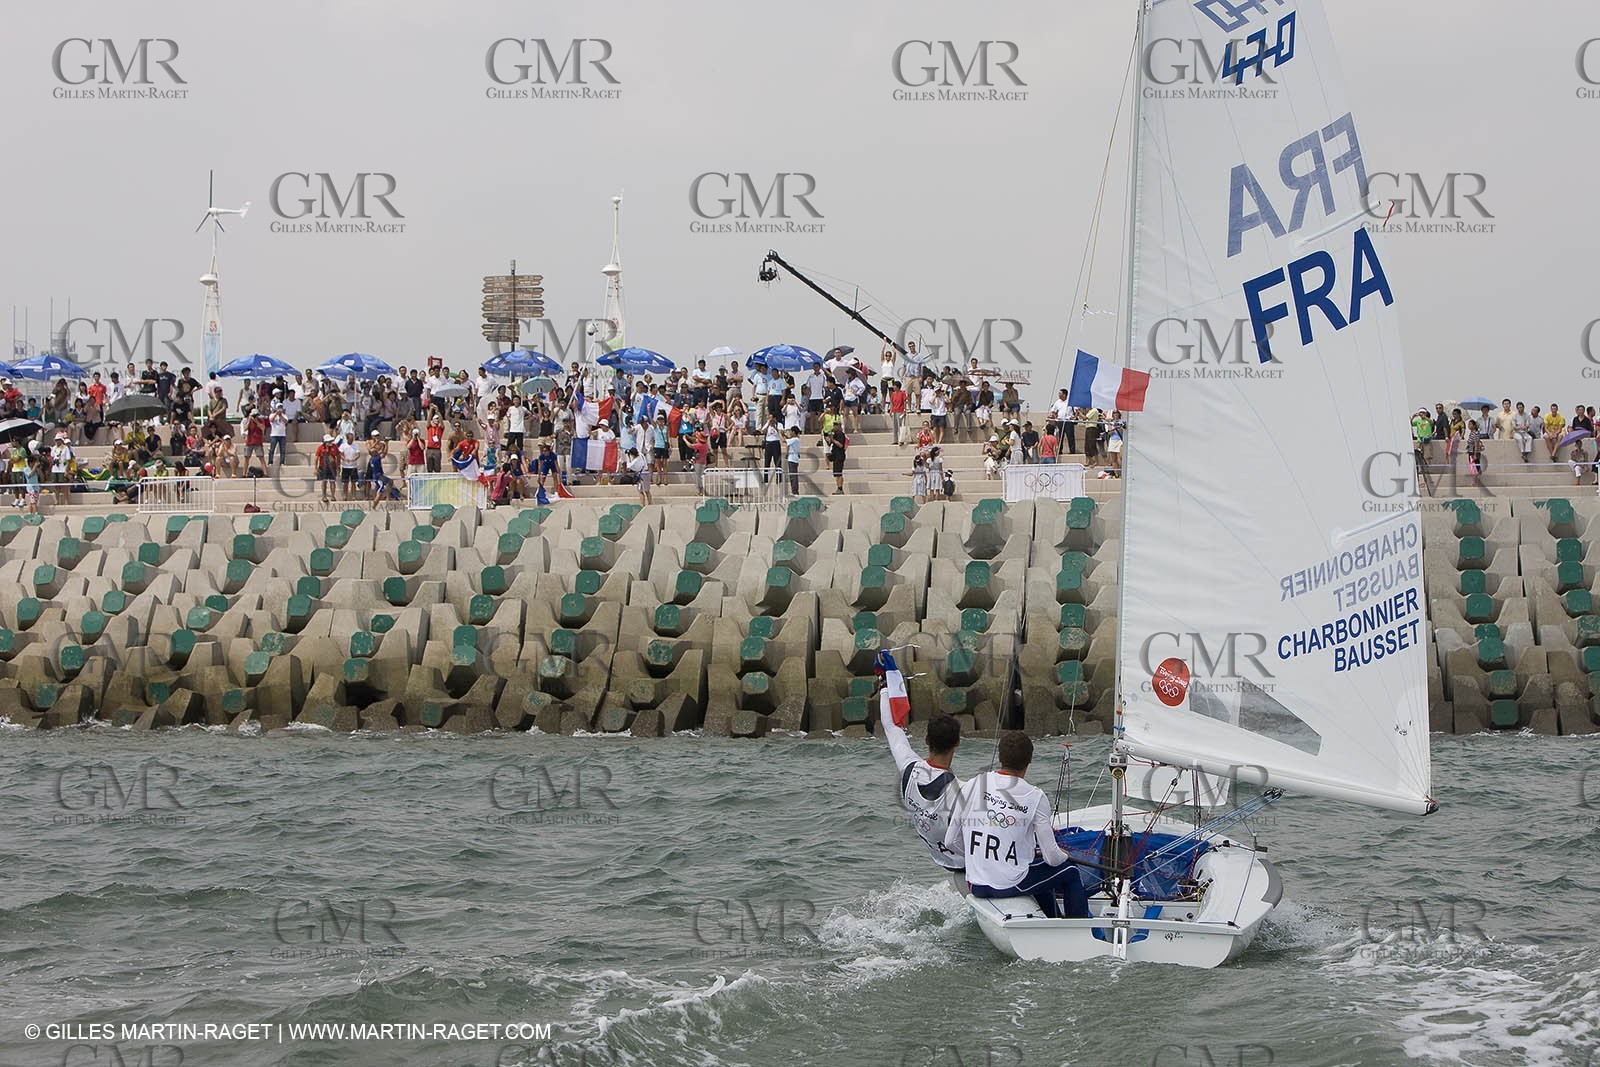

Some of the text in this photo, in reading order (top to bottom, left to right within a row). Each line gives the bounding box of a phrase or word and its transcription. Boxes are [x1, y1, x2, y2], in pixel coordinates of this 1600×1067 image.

[1221, 9, 1297, 87] 470
[1242, 226, 1394, 365] FRA
[1278, 587, 1419, 660] CHARBONNIER
[1334, 618, 1420, 672] BAUSSET
[1008, 802, 1029, 814] 2008
[969, 830, 1019, 866] FRA
